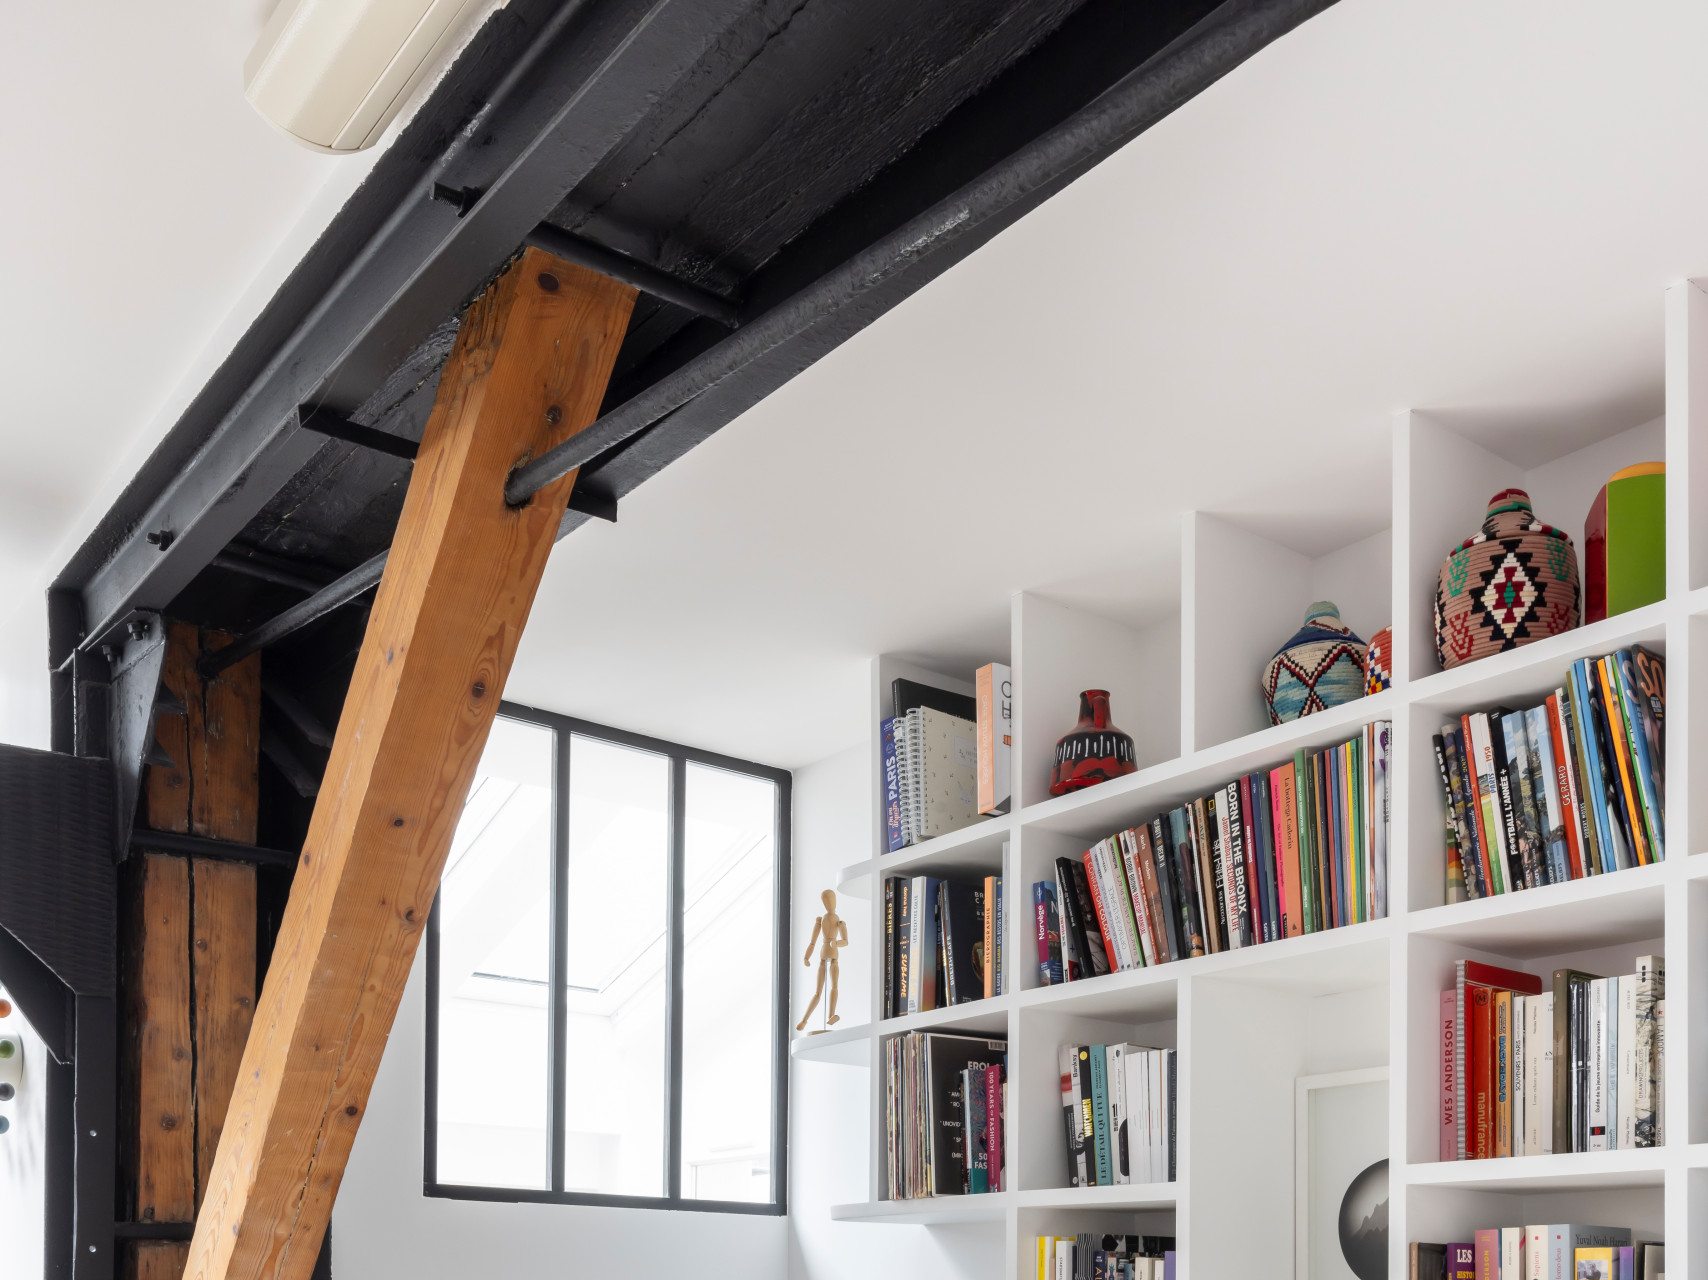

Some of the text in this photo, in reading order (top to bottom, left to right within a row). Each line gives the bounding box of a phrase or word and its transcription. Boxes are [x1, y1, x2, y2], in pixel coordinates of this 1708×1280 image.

[884, 755, 899, 800] PARIS
[1283, 777, 1290, 787] La
[1487, 772, 1497, 793] PARIS
[1555, 765, 1571, 806] GÉRARD
[1497, 775, 1519, 855] FOOTBALL L'ANNÉE
[1225, 781, 1248, 913] BORN IN THE BRONX
[1085, 861, 1101, 895] CONRAN
[1127, 873, 1138, 894] BROWN
[1220, 816, 1239, 932] Jamel Shabazz SECONDS OF MY LIFE
[1094, 895, 1103, 908] ON
[1132, 893, 1142, 915] MAKEUP
[1035, 904, 1046, 940] Norvège
[1097, 908, 1112, 941] COLOUR
[1136, 914, 1147, 936] MANUAL
[947, 956, 955, 985] BREIZH
[1498, 1035, 1507, 1064] BACK
[1071, 1053, 1079, 1077] Banksy
[1442, 1018, 1453, 1124] WES ANDERSON
[1081, 1098, 1094, 1137] WATCHMEN
[1477, 1091, 1486, 1160] manufrance
[1095, 1091, 1107, 1178] LE DÉTAIL QUI TUE
[979, 1153, 988, 1161] 50
[1576, 1234, 1629, 1246] Yuval Noah Harari
[1457, 1249, 1473, 1263] LES
[1533, 1250, 1541, 1276] Sapiens
